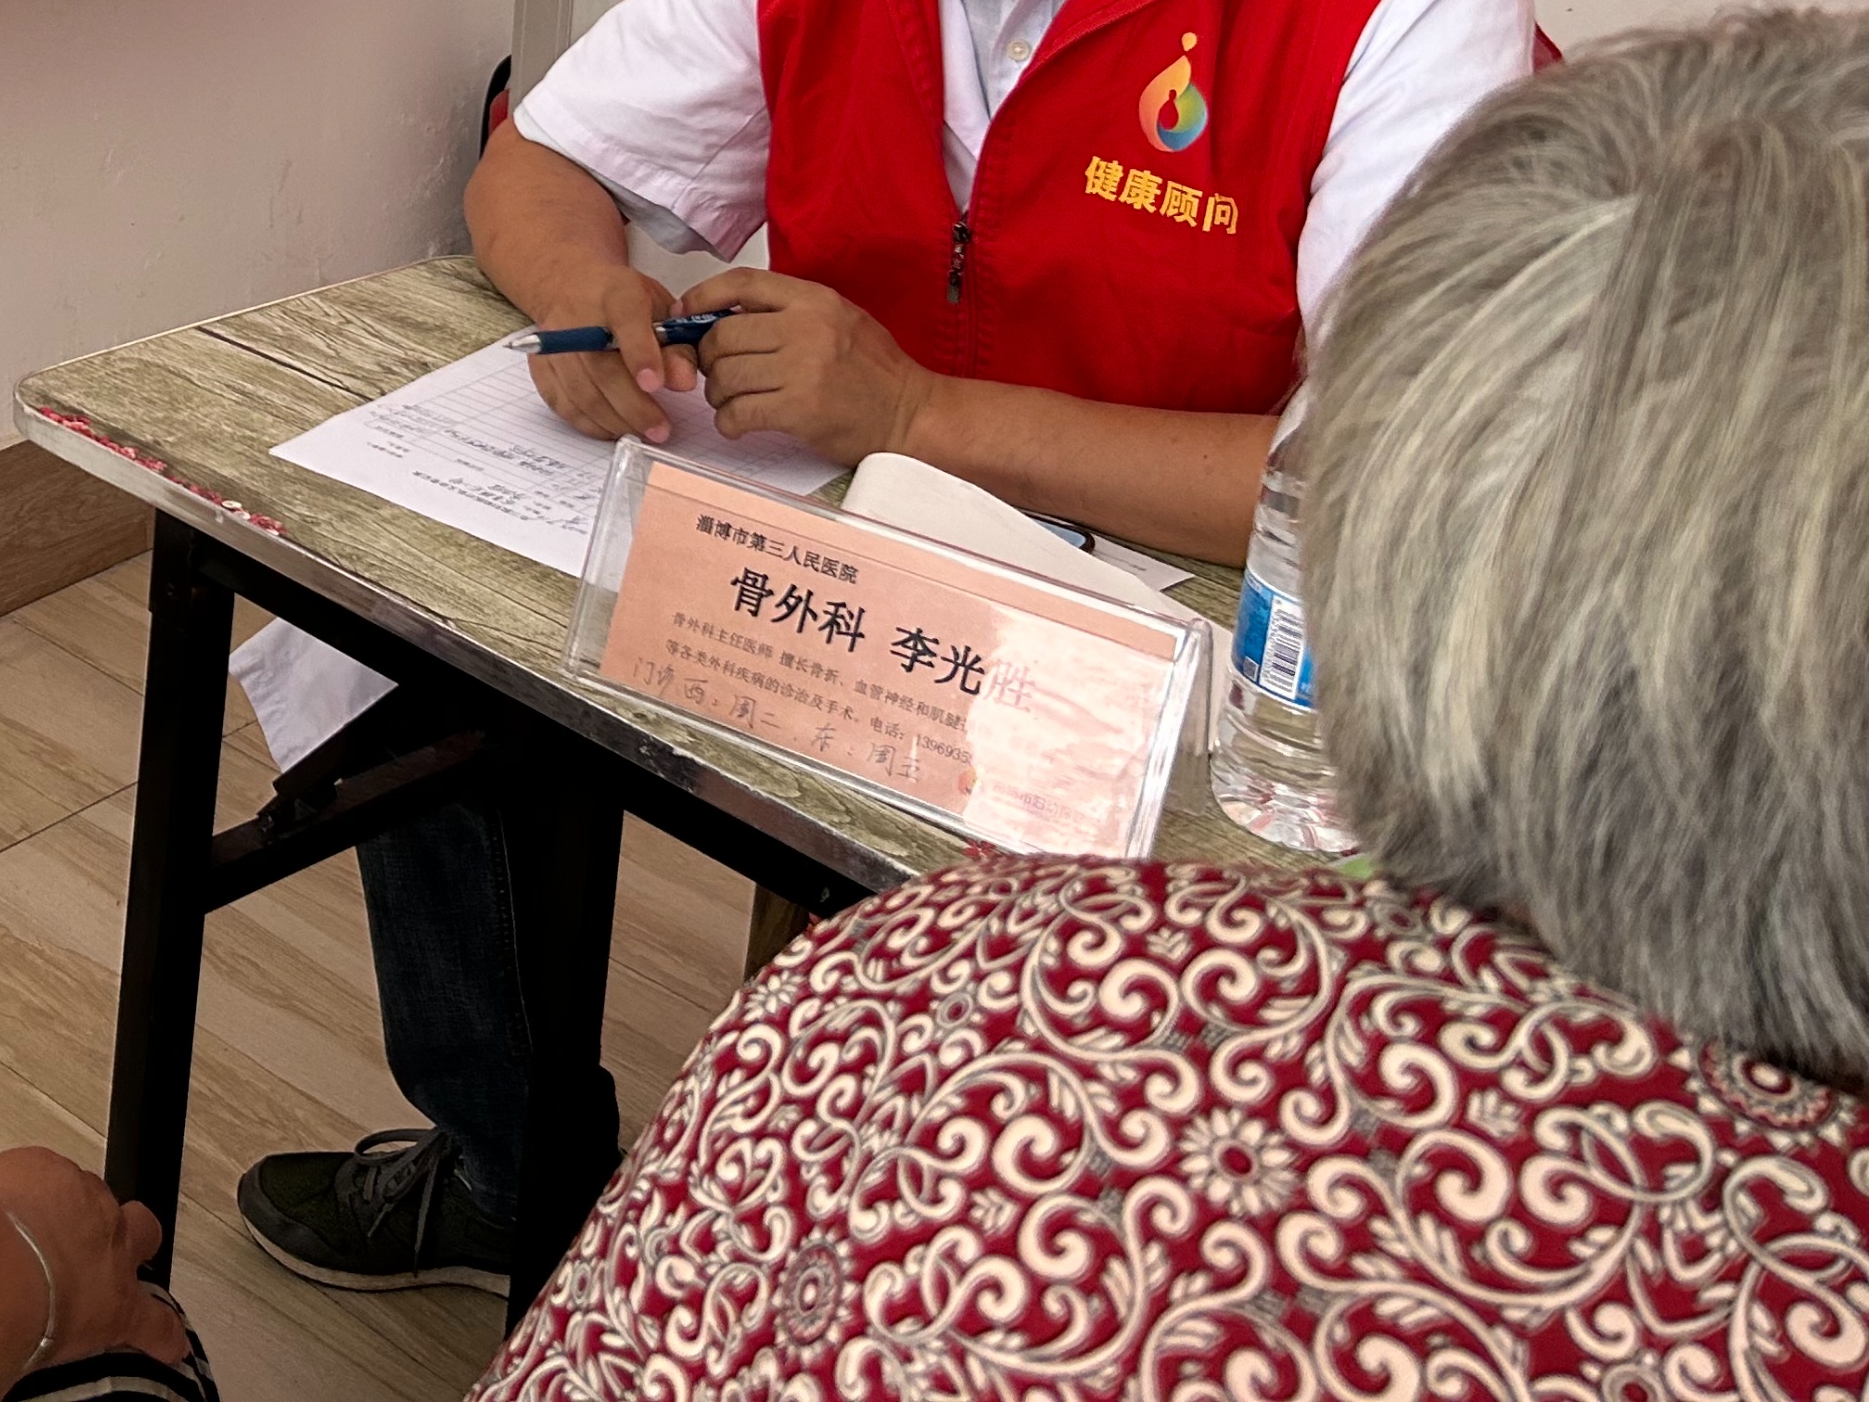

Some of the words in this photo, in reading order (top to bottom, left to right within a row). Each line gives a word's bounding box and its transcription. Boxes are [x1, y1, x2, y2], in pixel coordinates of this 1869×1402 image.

[1084, 155, 1239, 235] 健康顾问
[696, 514, 860, 585] 淄博市第三人民医院
[730, 567, 866, 653] 骨外科
[890, 625, 1036, 712] 李光胜
